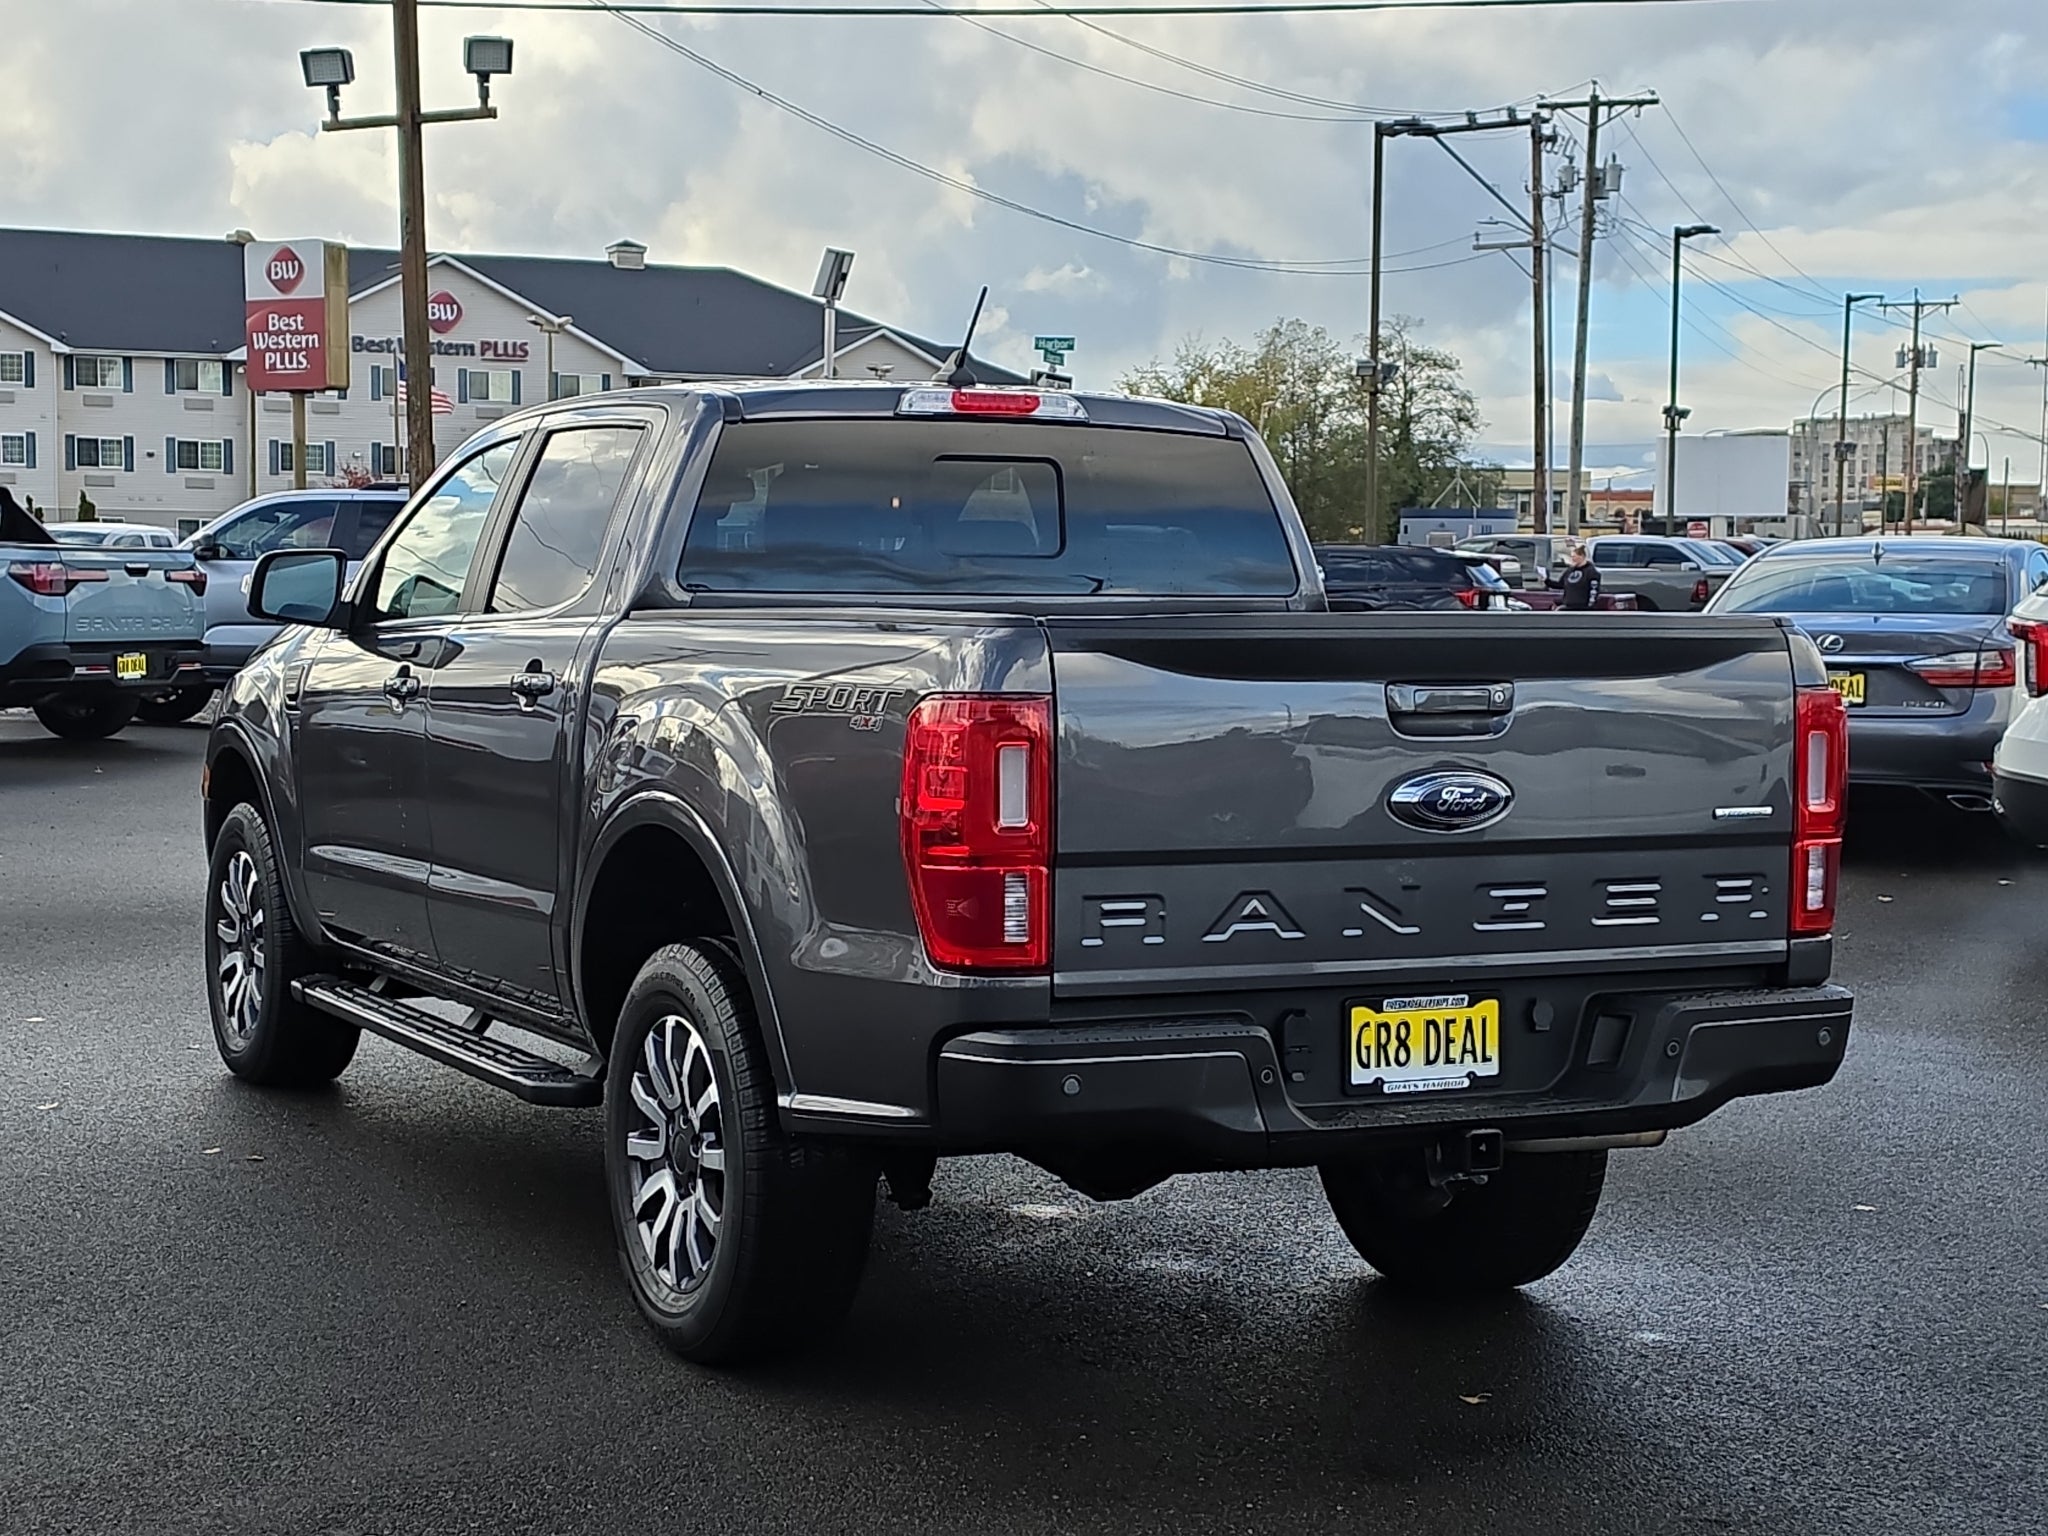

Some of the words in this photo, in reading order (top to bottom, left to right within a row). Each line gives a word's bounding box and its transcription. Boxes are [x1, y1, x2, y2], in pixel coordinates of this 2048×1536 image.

[270, 260, 299, 281] BW
[268, 313, 305, 331] Best
[428, 302, 459, 321] BW
[252, 330, 319, 350] Western
[351, 335, 394, 353] Best
[480, 340, 529, 358] PLUS
[264, 351, 308, 371] PLUS
[769, 682, 906, 715] SPORT
[1436, 786, 1488, 811] Ford
[1081, 873, 1769, 946] RANGER
[1355, 1018, 1411, 1070] GR8
[1423, 1015, 1493, 1066] DEAL
[1386, 1083, 1420, 1092] GRAYS
[1422, 1079, 1465, 1090] HARBOR
